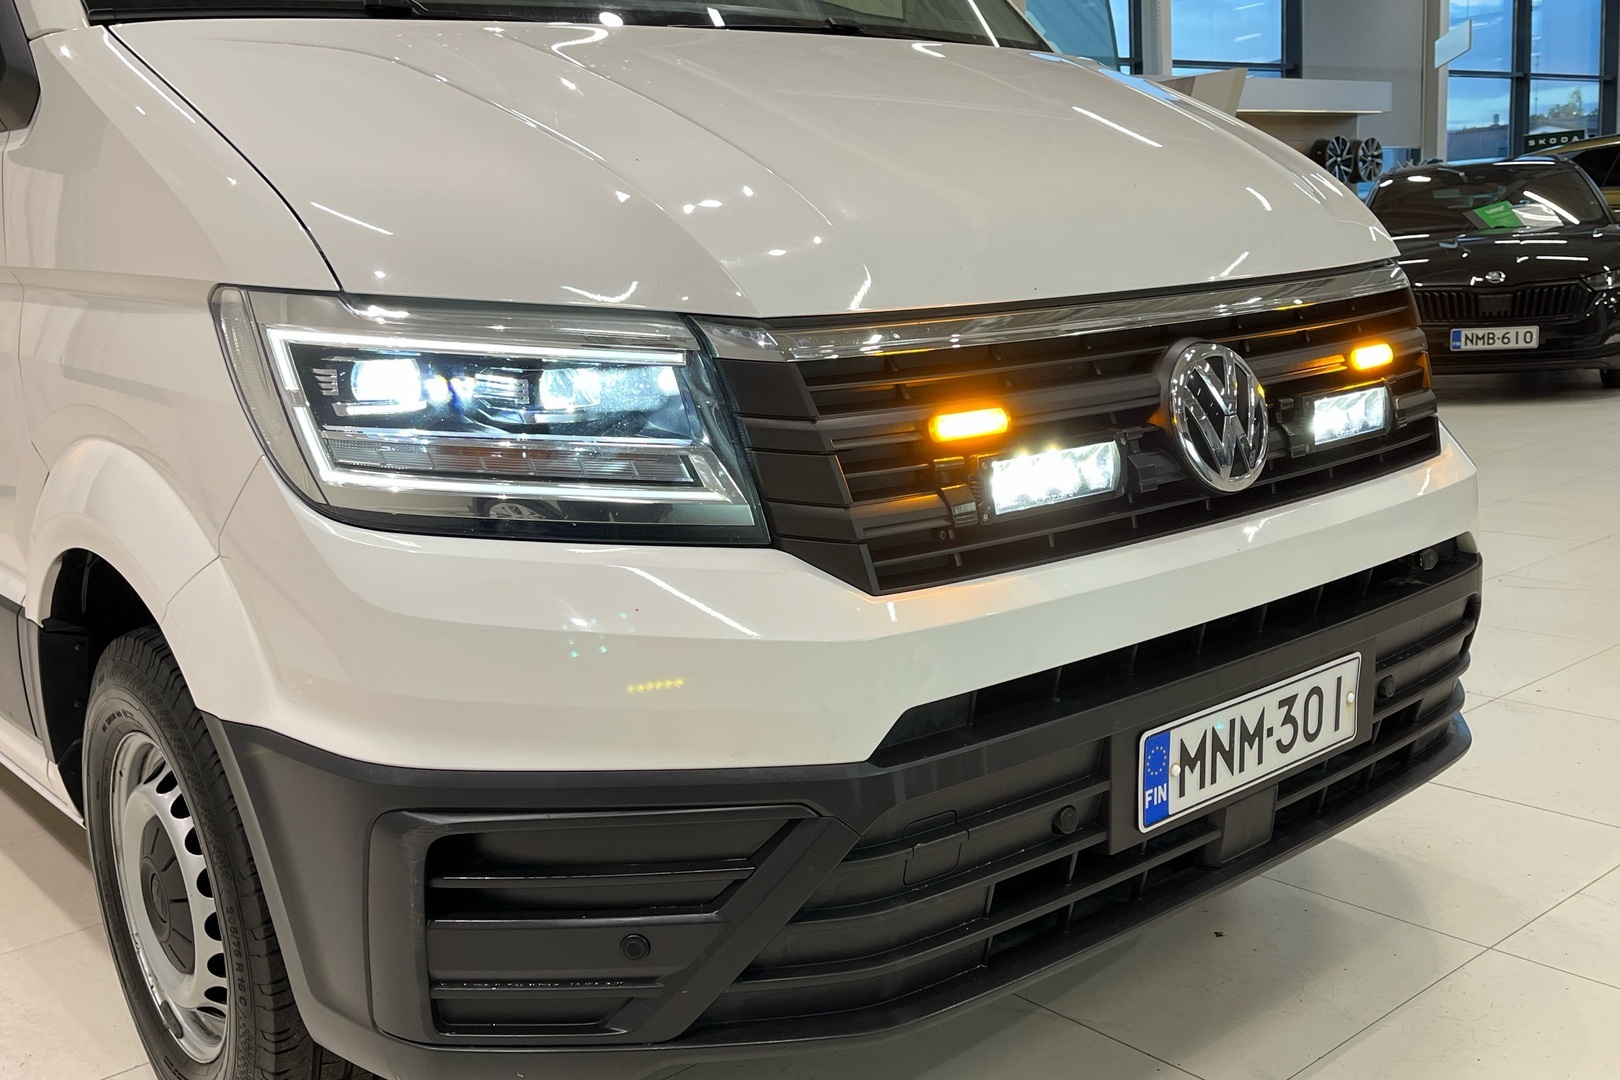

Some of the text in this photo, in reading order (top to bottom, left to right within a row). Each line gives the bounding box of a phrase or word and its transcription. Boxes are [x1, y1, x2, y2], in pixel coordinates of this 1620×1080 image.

[1464, 331, 1533, 346] NMB-610
[1179, 676, 1342, 798] MNM-301
[1144, 783, 1167, 809] FIN
[225, 906, 241, 958] 205/75
[239, 996, 248, 1006] C
